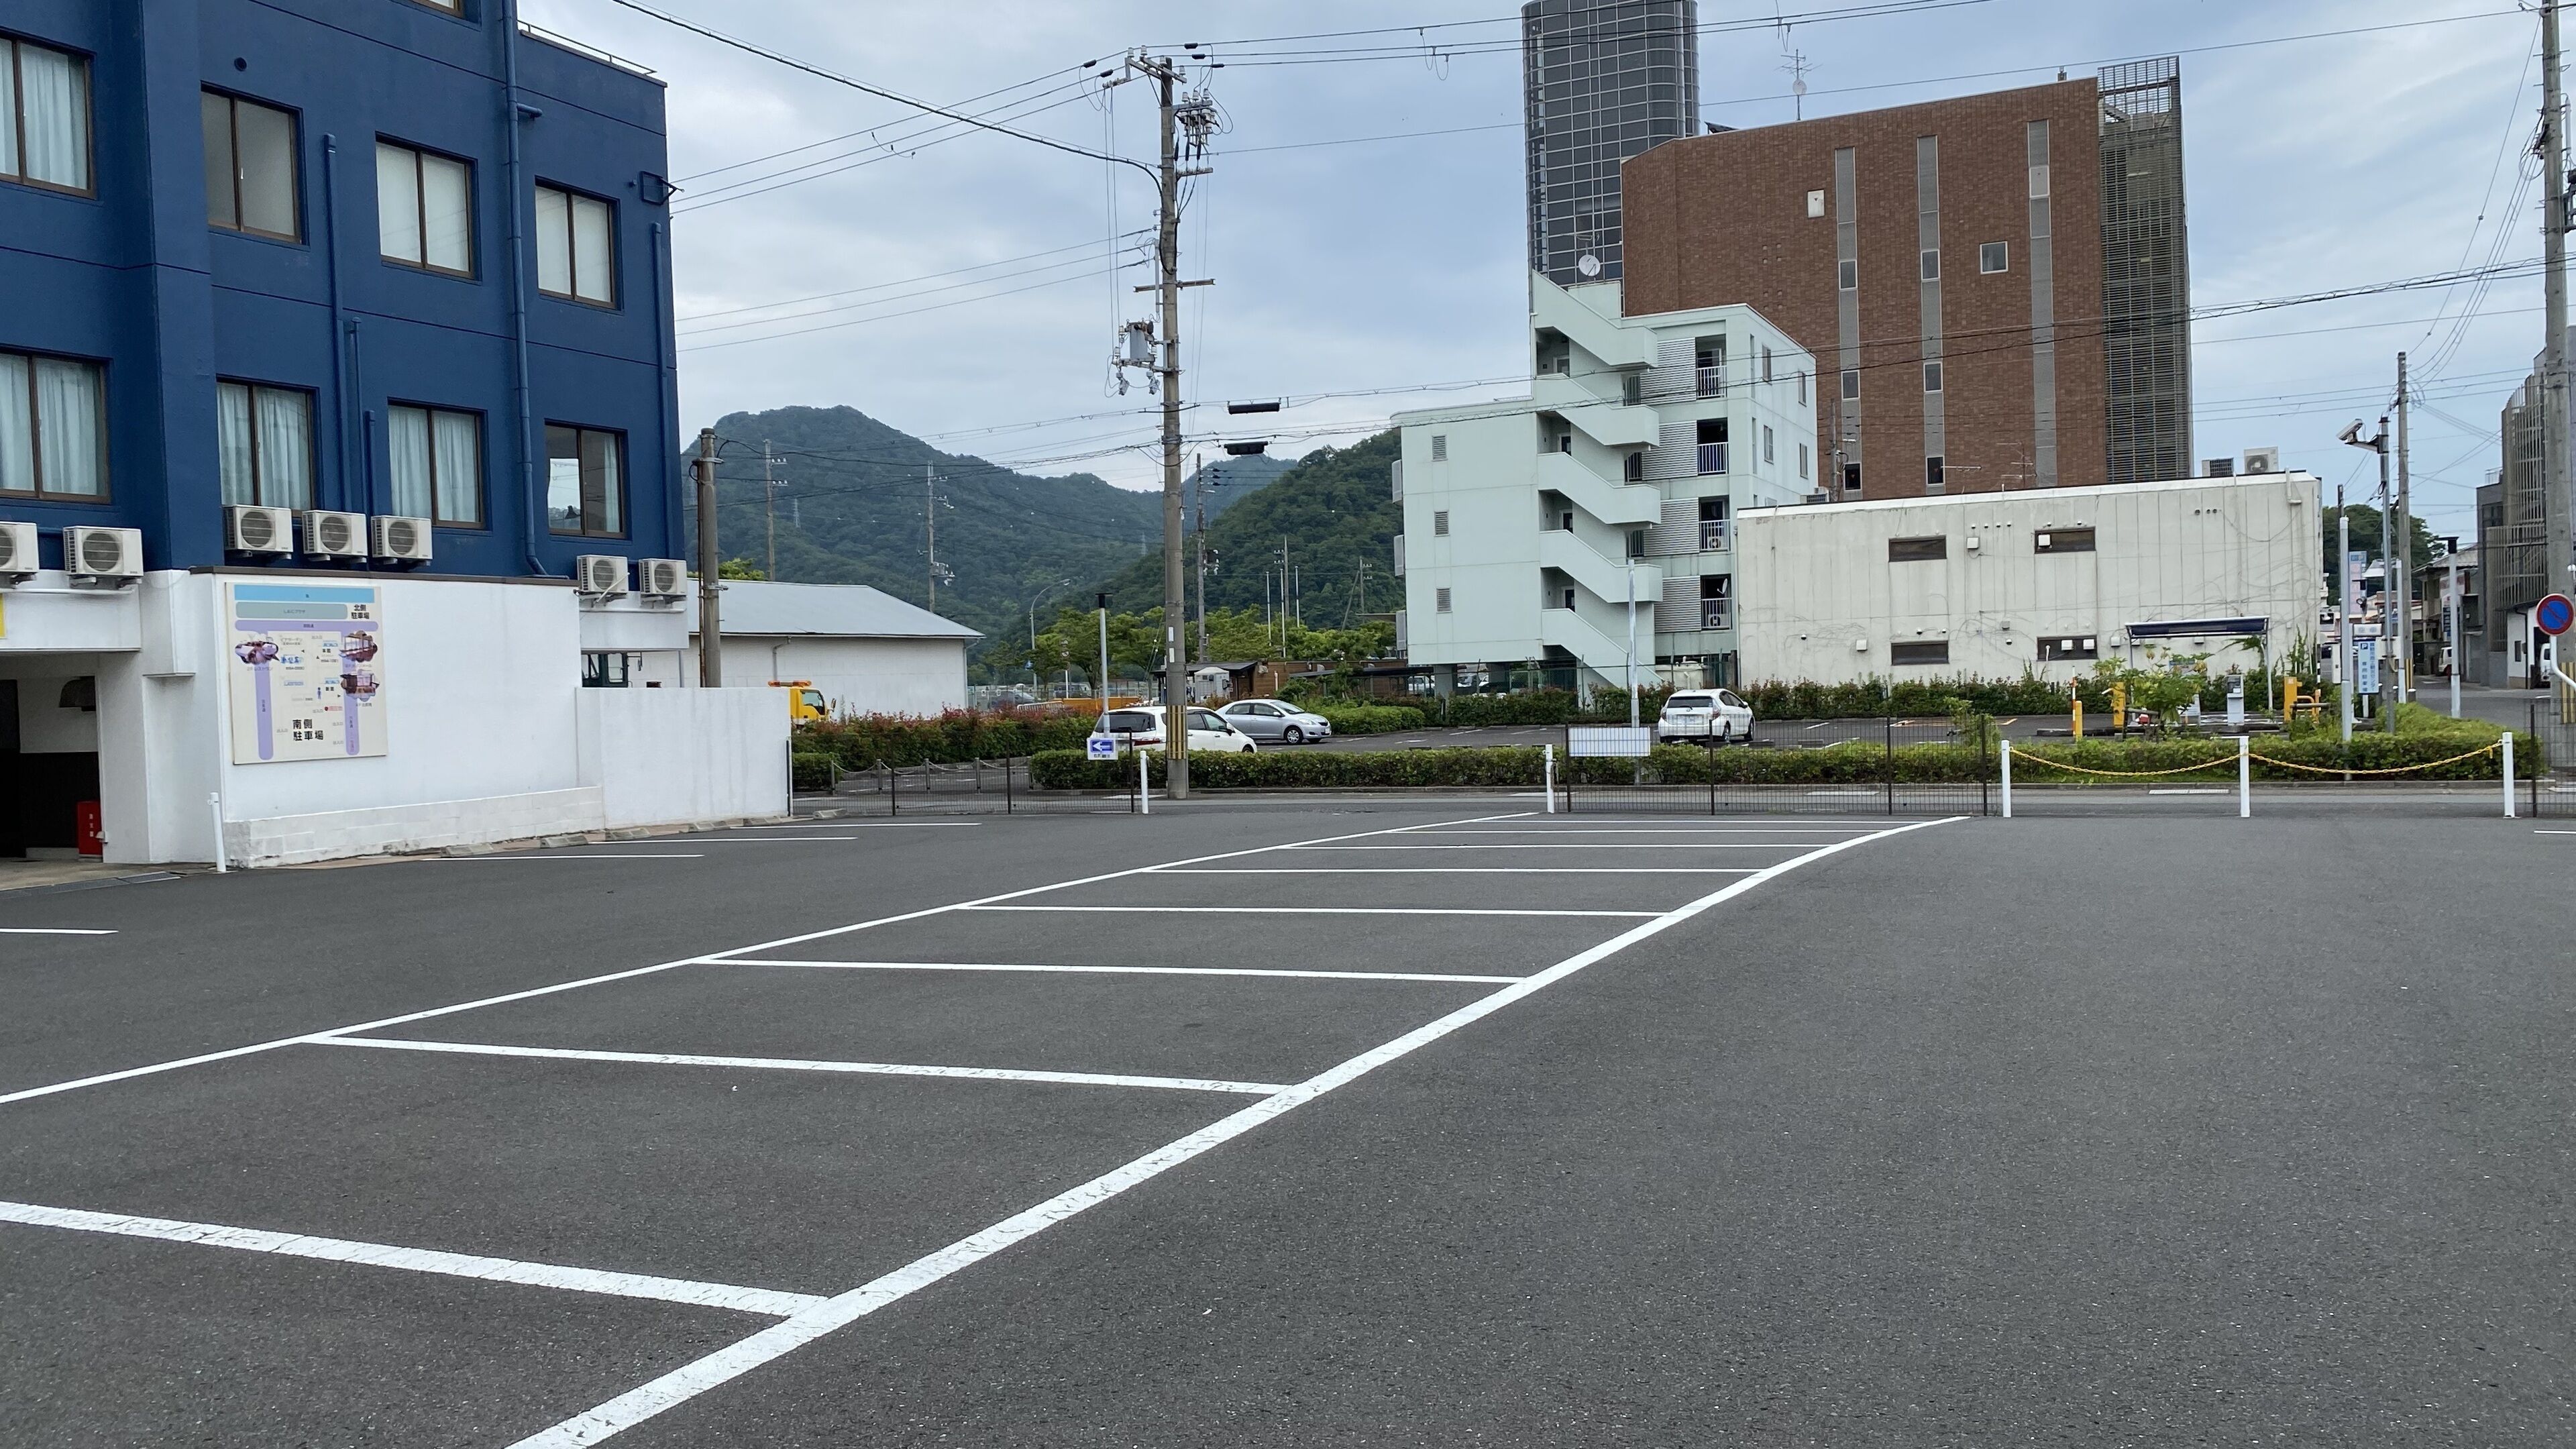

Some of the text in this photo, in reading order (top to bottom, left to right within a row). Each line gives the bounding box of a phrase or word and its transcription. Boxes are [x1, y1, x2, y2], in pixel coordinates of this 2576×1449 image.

[292, 718, 313, 730] 南側
[293, 730, 323, 741] 駐車場
